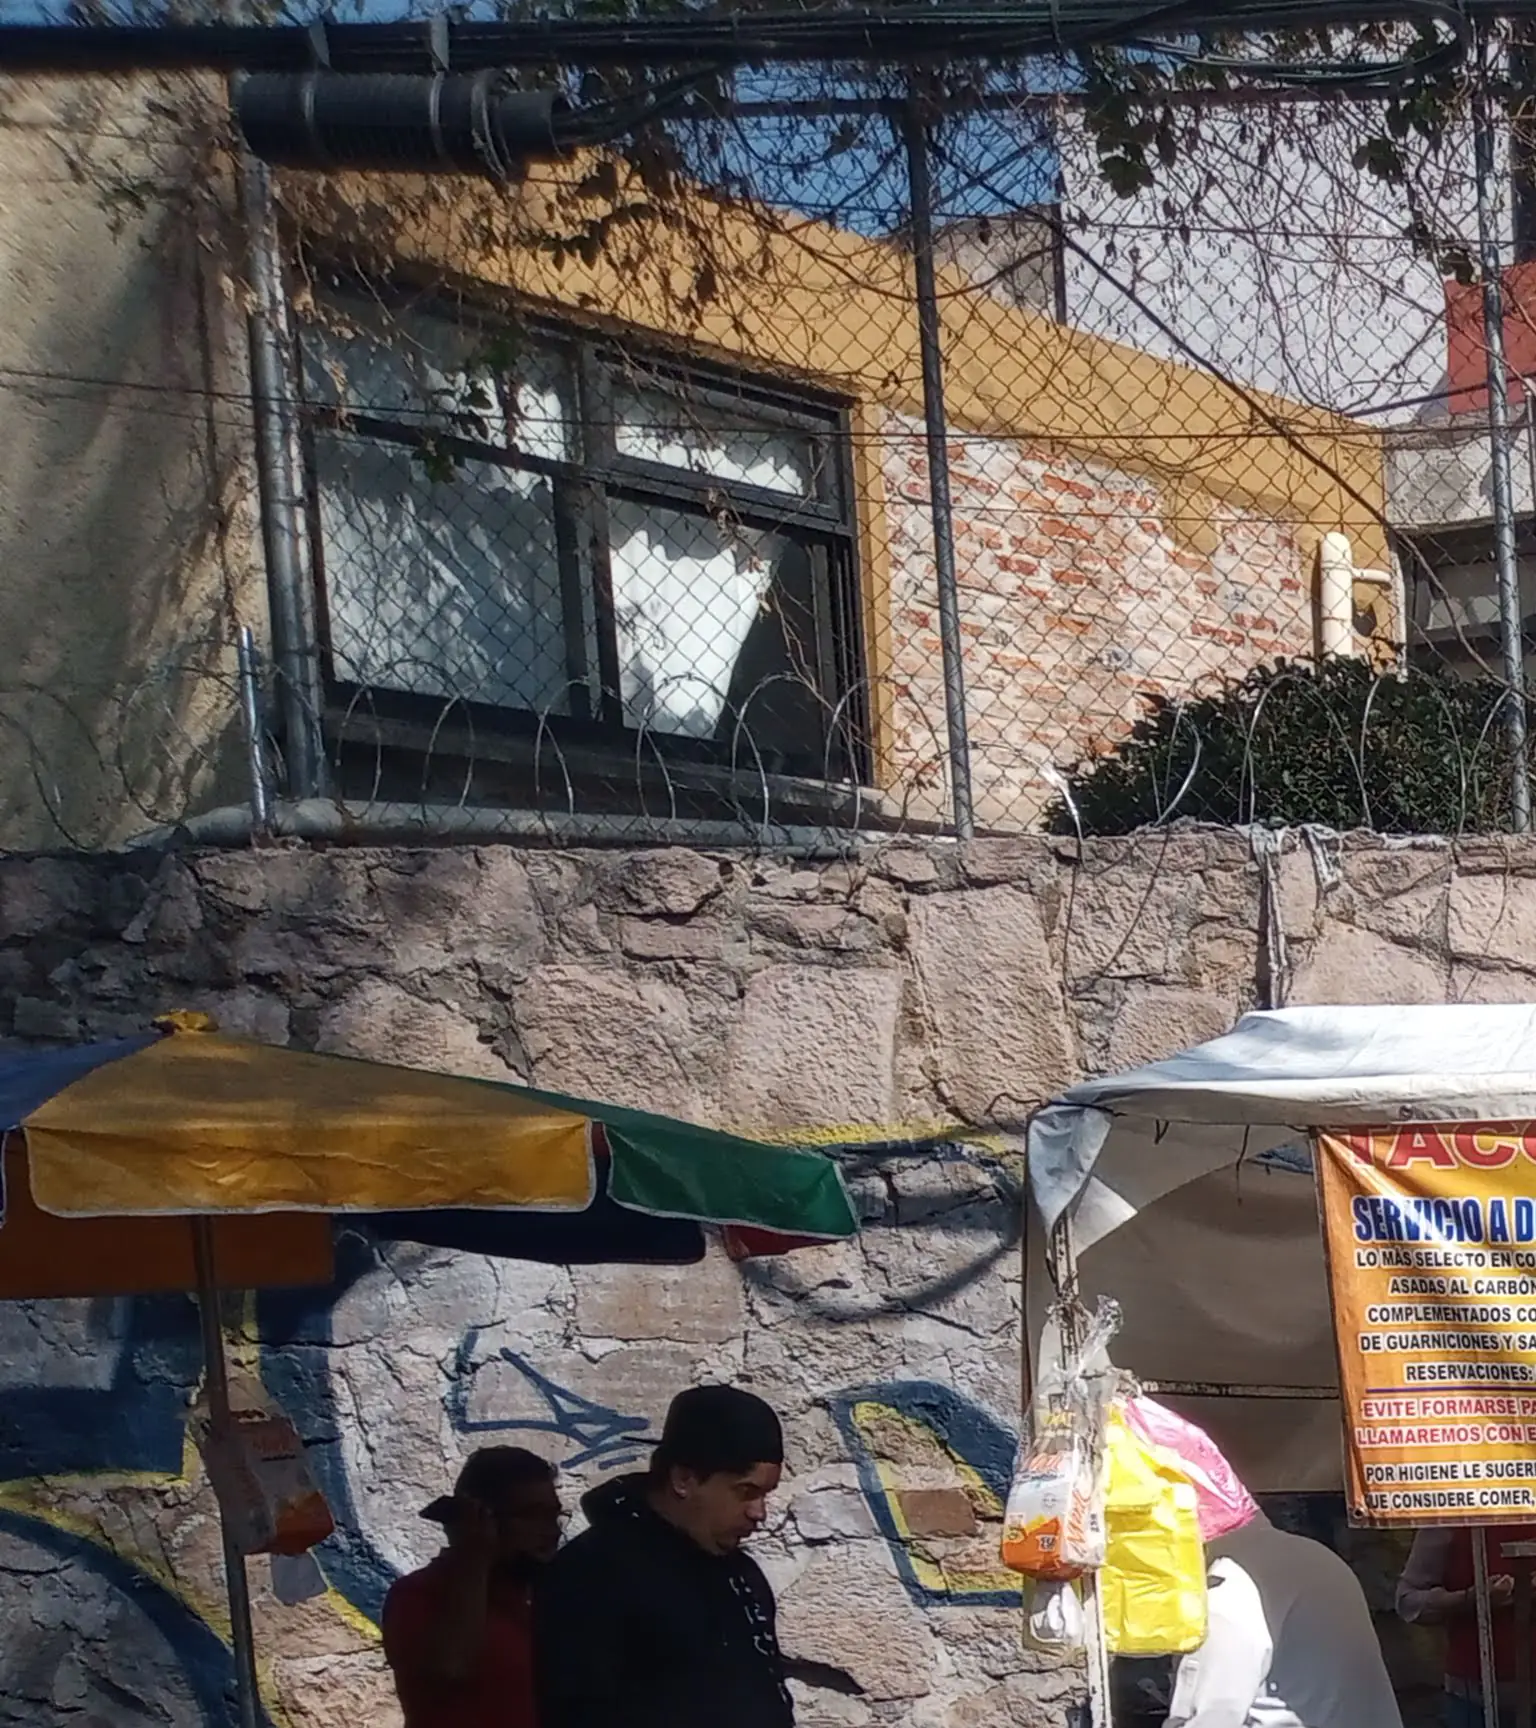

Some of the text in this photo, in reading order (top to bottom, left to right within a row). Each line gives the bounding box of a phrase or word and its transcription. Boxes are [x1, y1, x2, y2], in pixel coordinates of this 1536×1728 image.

[1353, 1196, 1485, 1243] SERVICIO
[1356, 1251, 1378, 1268] LO
[1415, 1251, 1486, 1268] SELECTO
[1490, 1251, 1512, 1268] EN
[1390, 1278, 1447, 1295] ASADAS
[1450, 1278, 1470, 1296] AL
[1368, 1306, 1511, 1323] COMPLEMENTADOS
[1360, 1334, 1382, 1351] DE
[1386, 1333, 1500, 1350] GUARNICIONES
[1406, 1364, 1534, 1381] RESERVACIONES:
[1363, 1400, 1417, 1418] EVITE
[1421, 1399, 1518, 1416] FORMARSE
[1356, 1427, 1481, 1445] LLAMAREMOS
[1485, 1427, 1523, 1443] CON
[1365, 1465, 1396, 1483] POR
[1398, 1464, 1459, 1481] HIGIENE
[1462, 1464, 1481, 1480] LE
[1392, 1491, 1475, 1508] CONSIDERE
[1479, 1490, 1536, 1509] COMER,
